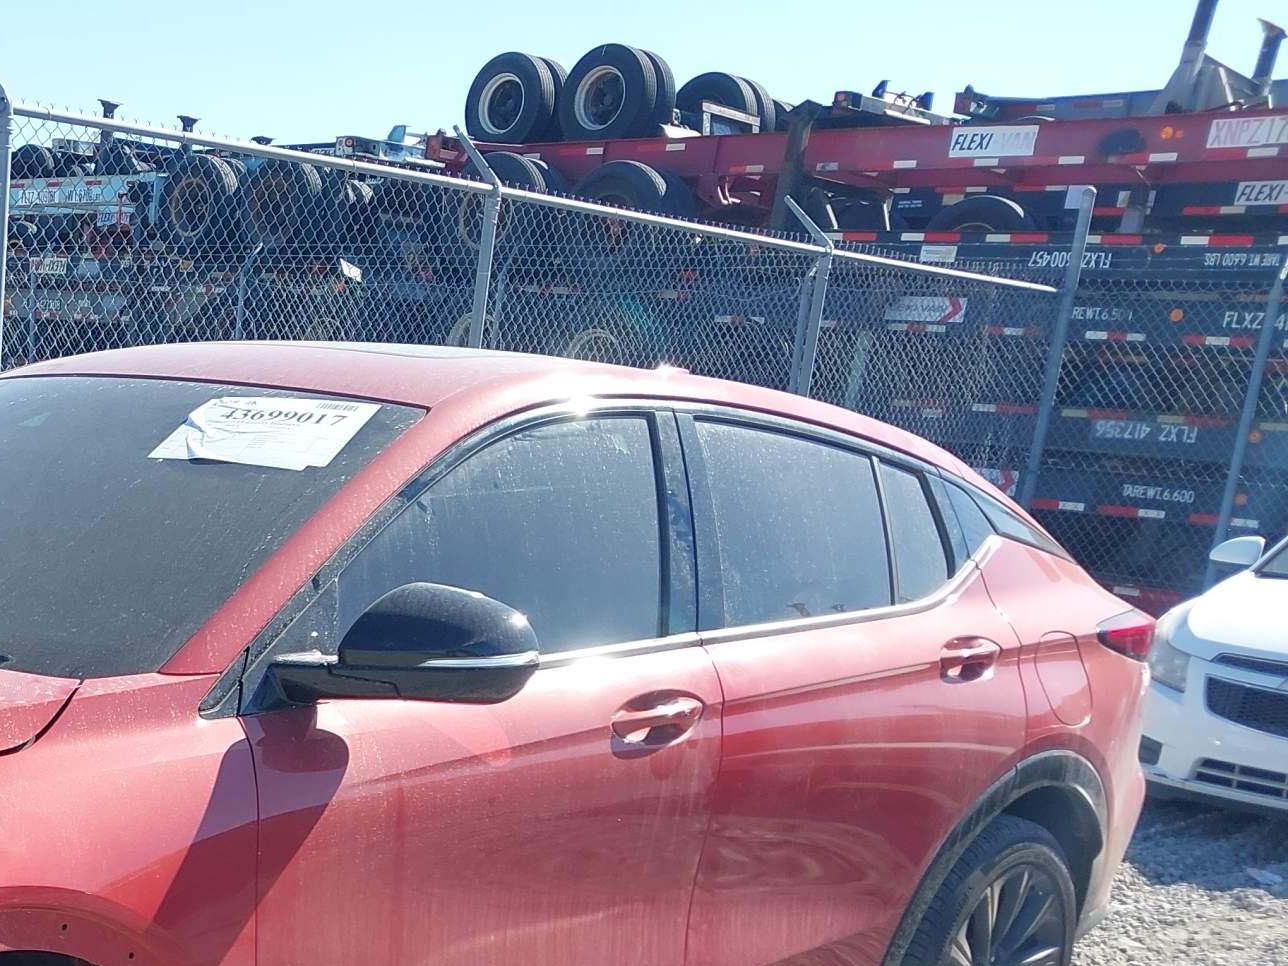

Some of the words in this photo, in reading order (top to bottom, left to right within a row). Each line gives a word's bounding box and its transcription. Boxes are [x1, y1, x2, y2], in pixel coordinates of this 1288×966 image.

[1081, 252, 1112, 269] FLXZ
[1204, 253, 1221, 266] LBS
[1222, 311, 1265, 329] FLXZ
[220, 406, 349, 427] 43699017
[1158, 424, 1198, 443] FLXZ
